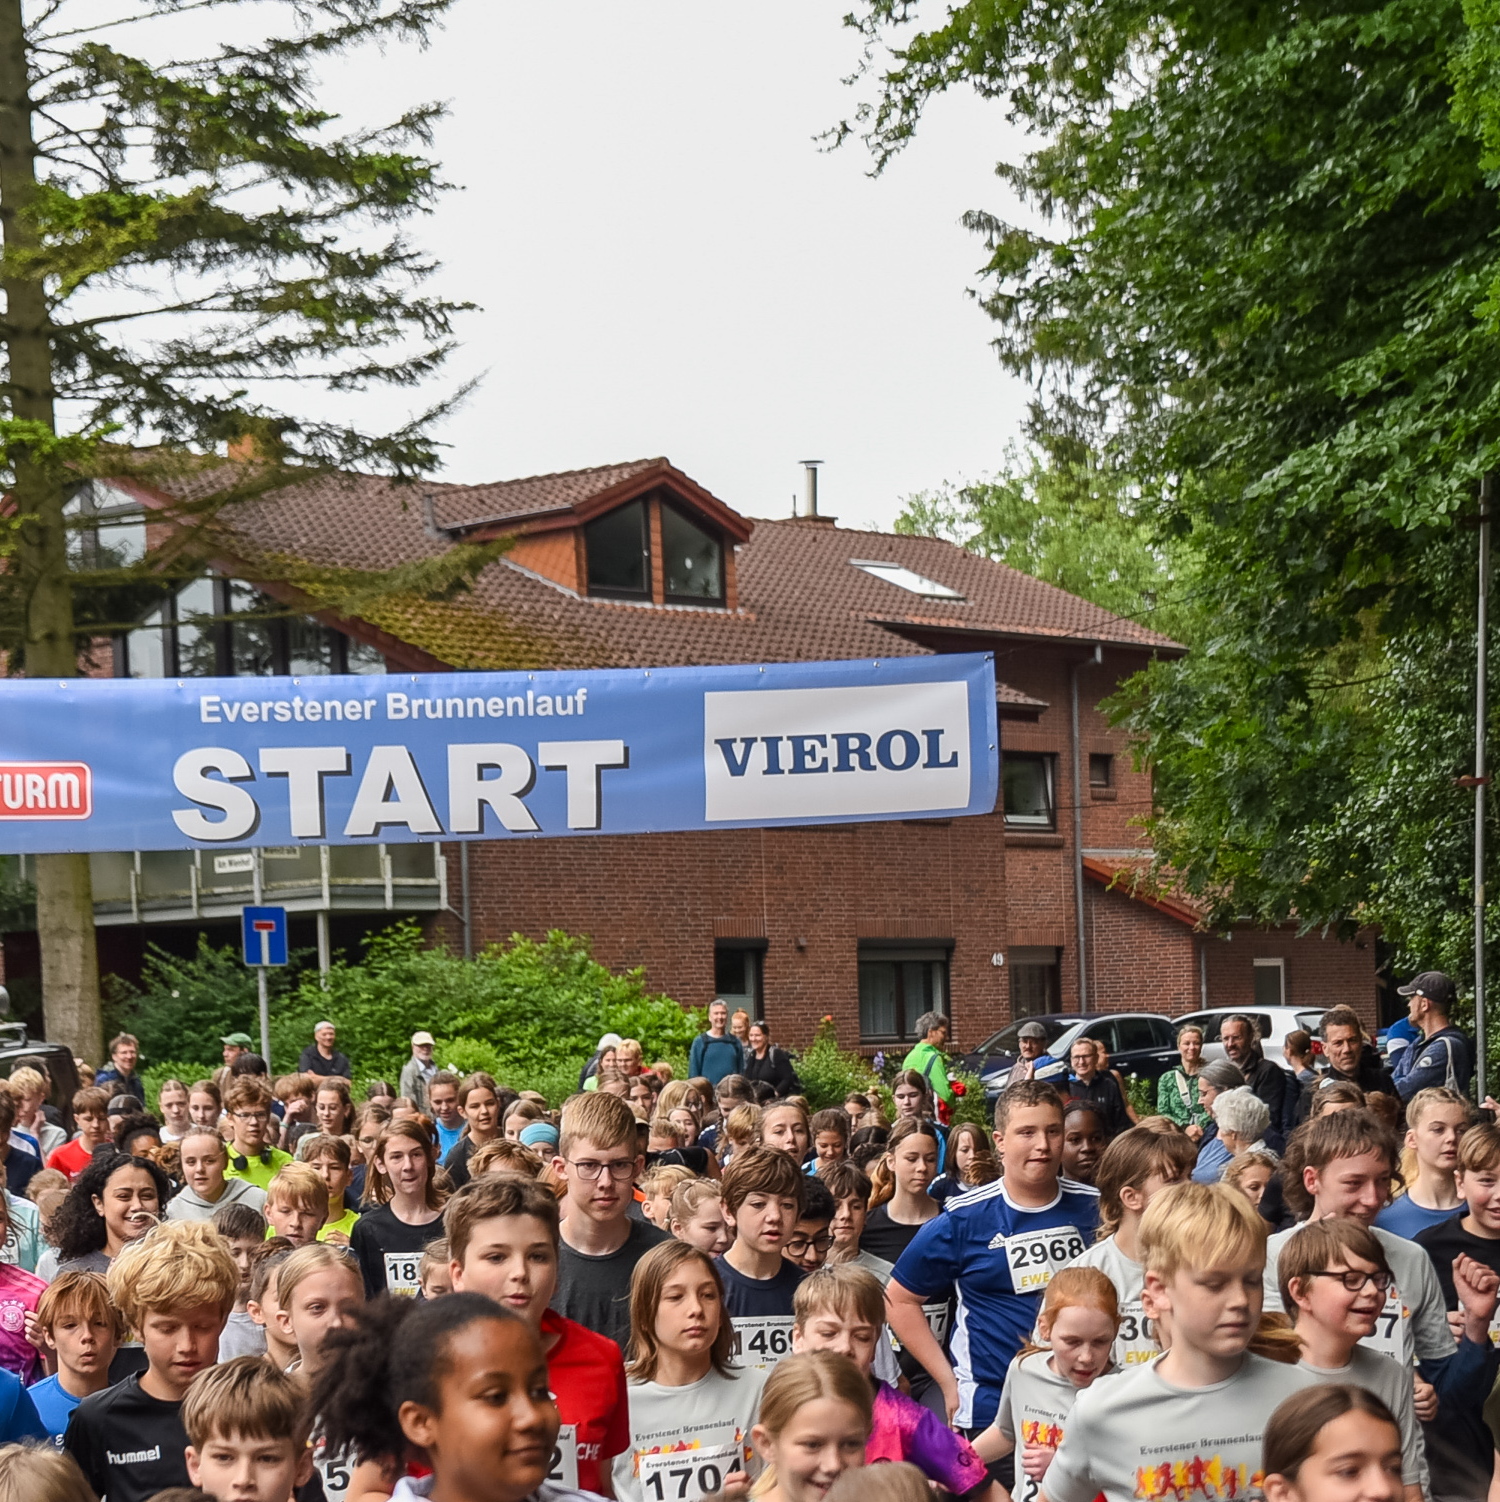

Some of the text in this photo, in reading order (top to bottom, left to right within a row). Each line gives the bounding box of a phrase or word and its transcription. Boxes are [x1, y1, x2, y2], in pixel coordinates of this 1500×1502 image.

[200, 689, 587, 723] Everstener Brunnenlauf
[714, 729, 958, 777] VIEROL
[172, 739, 626, 841] START
[1010, 1237, 1084, 1269] 2968
[389, 1263, 417, 1281] 18
[1021, 1271, 1050, 1287] EWE
[635, 1418, 736, 1442] Everstener Brunnenlauf
[106, 1444, 161, 1464] hummel
[1140, 1433, 1263, 1455] Everstener Brunnenlau
[646, 1449, 738, 1469] Everstener Brunnenlauf
[645, 1457, 741, 1501] 1704
